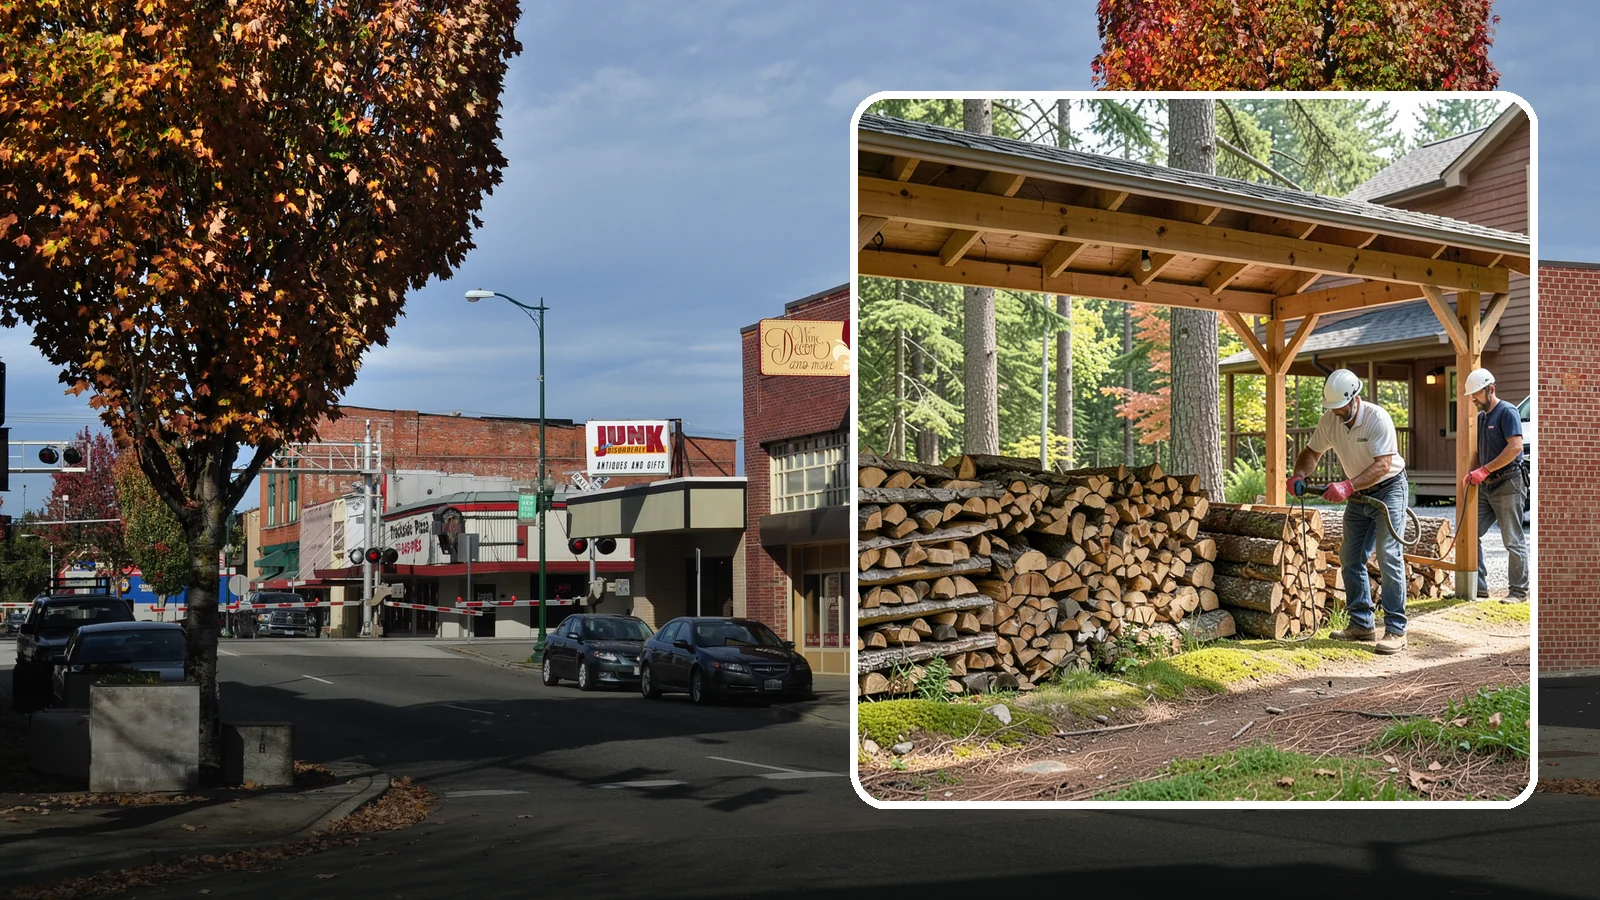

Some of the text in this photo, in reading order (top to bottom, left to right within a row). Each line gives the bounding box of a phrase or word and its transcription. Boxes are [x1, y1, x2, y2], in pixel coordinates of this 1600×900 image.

[595, 425, 665, 457] JUNK
[597, 461, 665, 470] ANTIQUES AND GIFTS
[414, 519, 429, 535] Pizza
